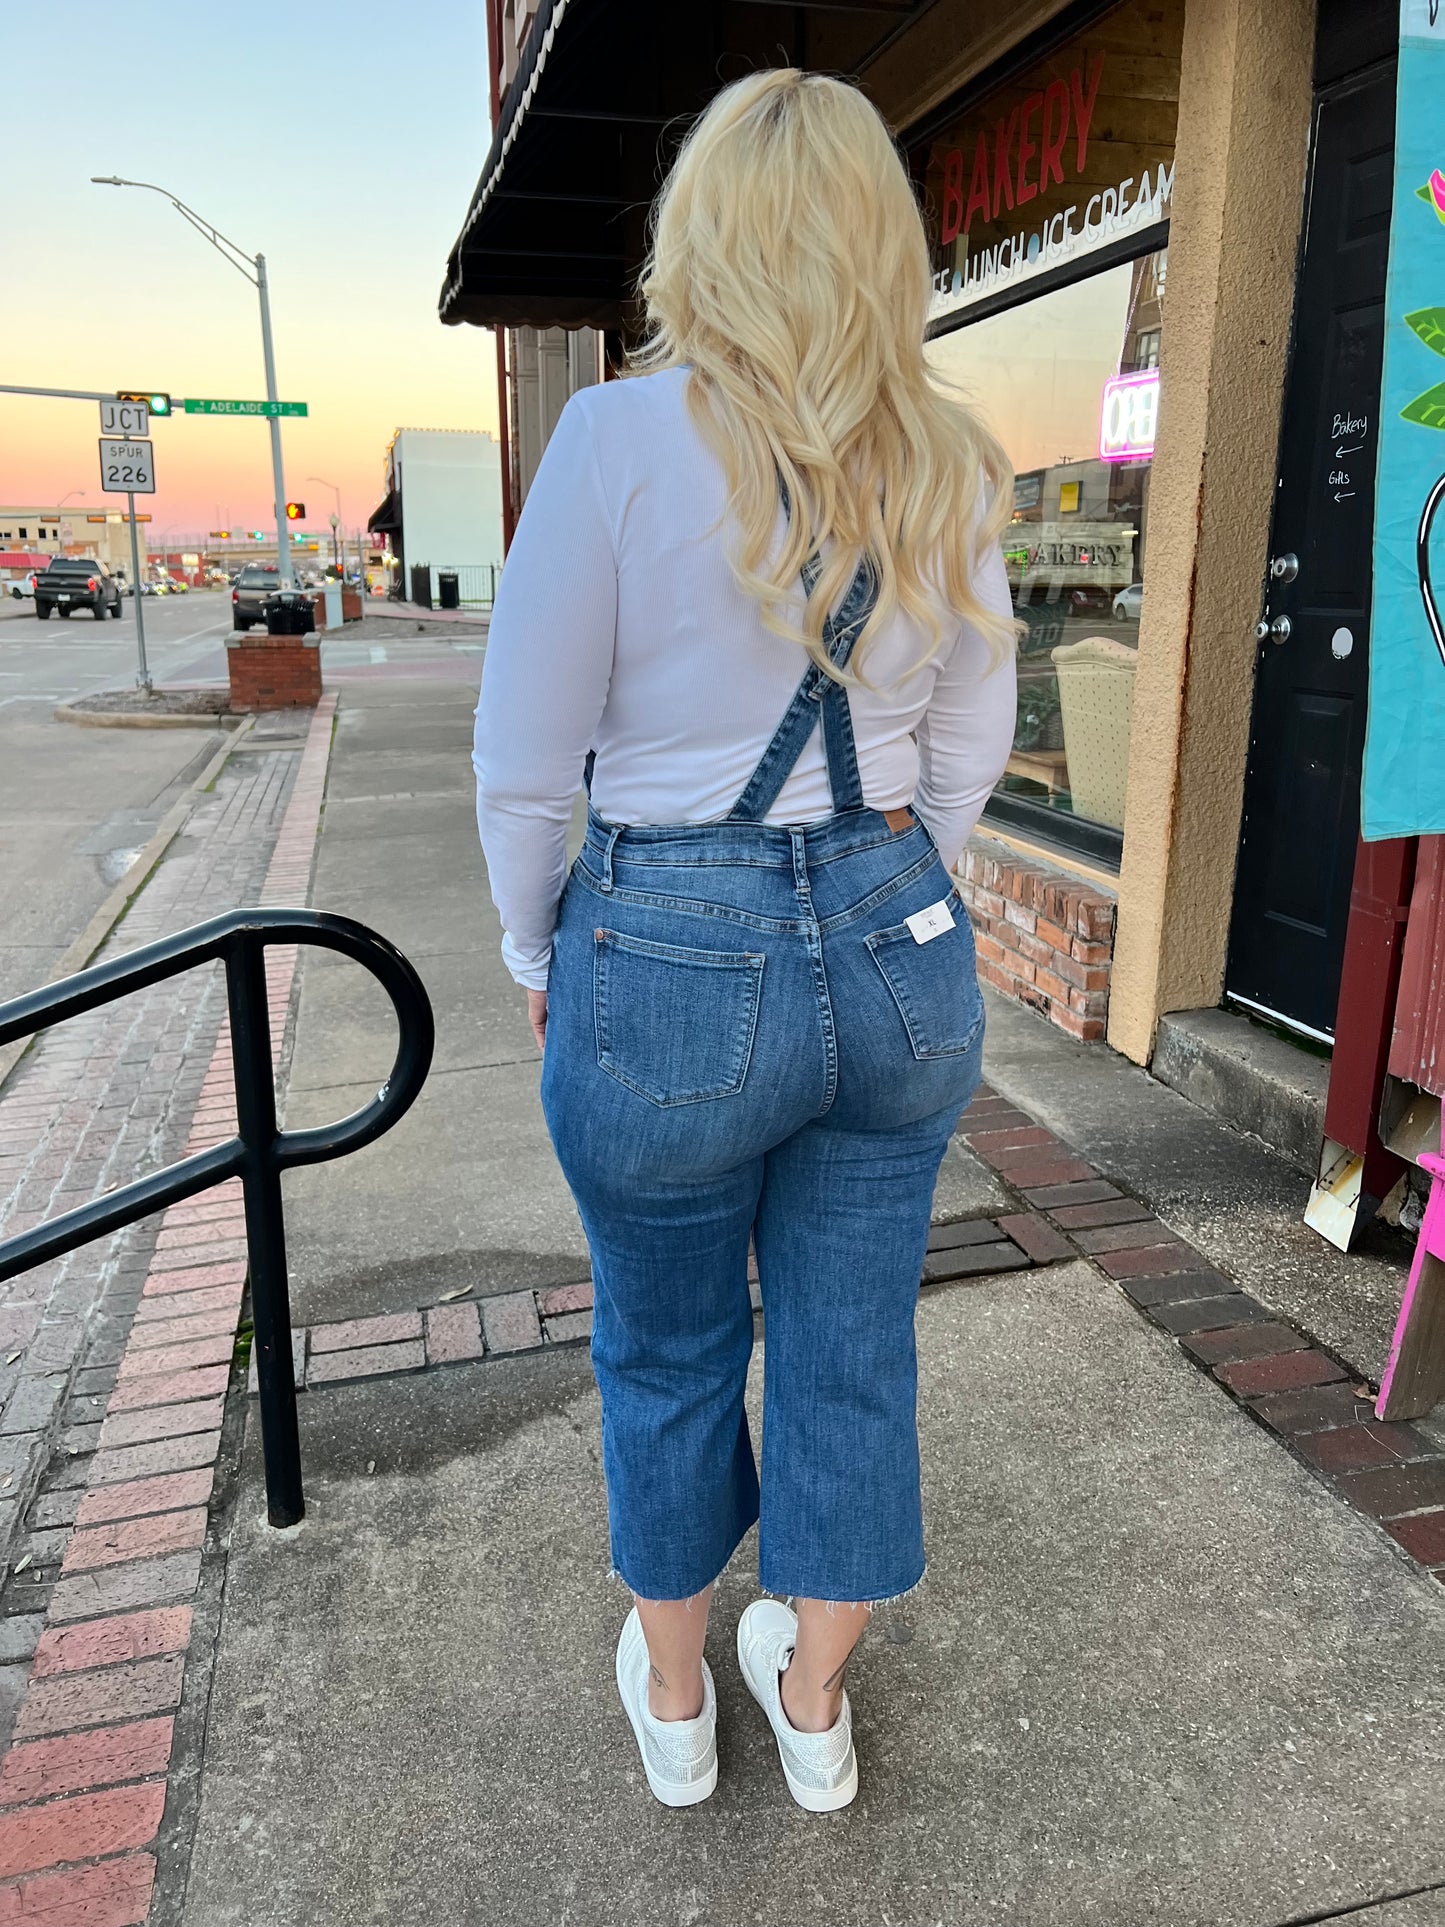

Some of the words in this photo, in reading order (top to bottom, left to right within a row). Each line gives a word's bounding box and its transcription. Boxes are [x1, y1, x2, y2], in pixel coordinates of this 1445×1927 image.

[942, 50, 1104, 246] BAKERY
[964, 231, 1025, 297] LUNCH
[1042, 205, 1077, 263] ICE
[1084, 160, 1175, 243] CREAM
[105, 408, 144, 431] JCT
[210, 401, 264, 413] ADELAIDE
[271, 403, 284, 413] ST
[1103, 383, 1158, 444] OPE
[1331, 411, 1367, 439] Bakery
[110, 446, 143, 458] SPUR
[108, 466, 147, 483] 226
